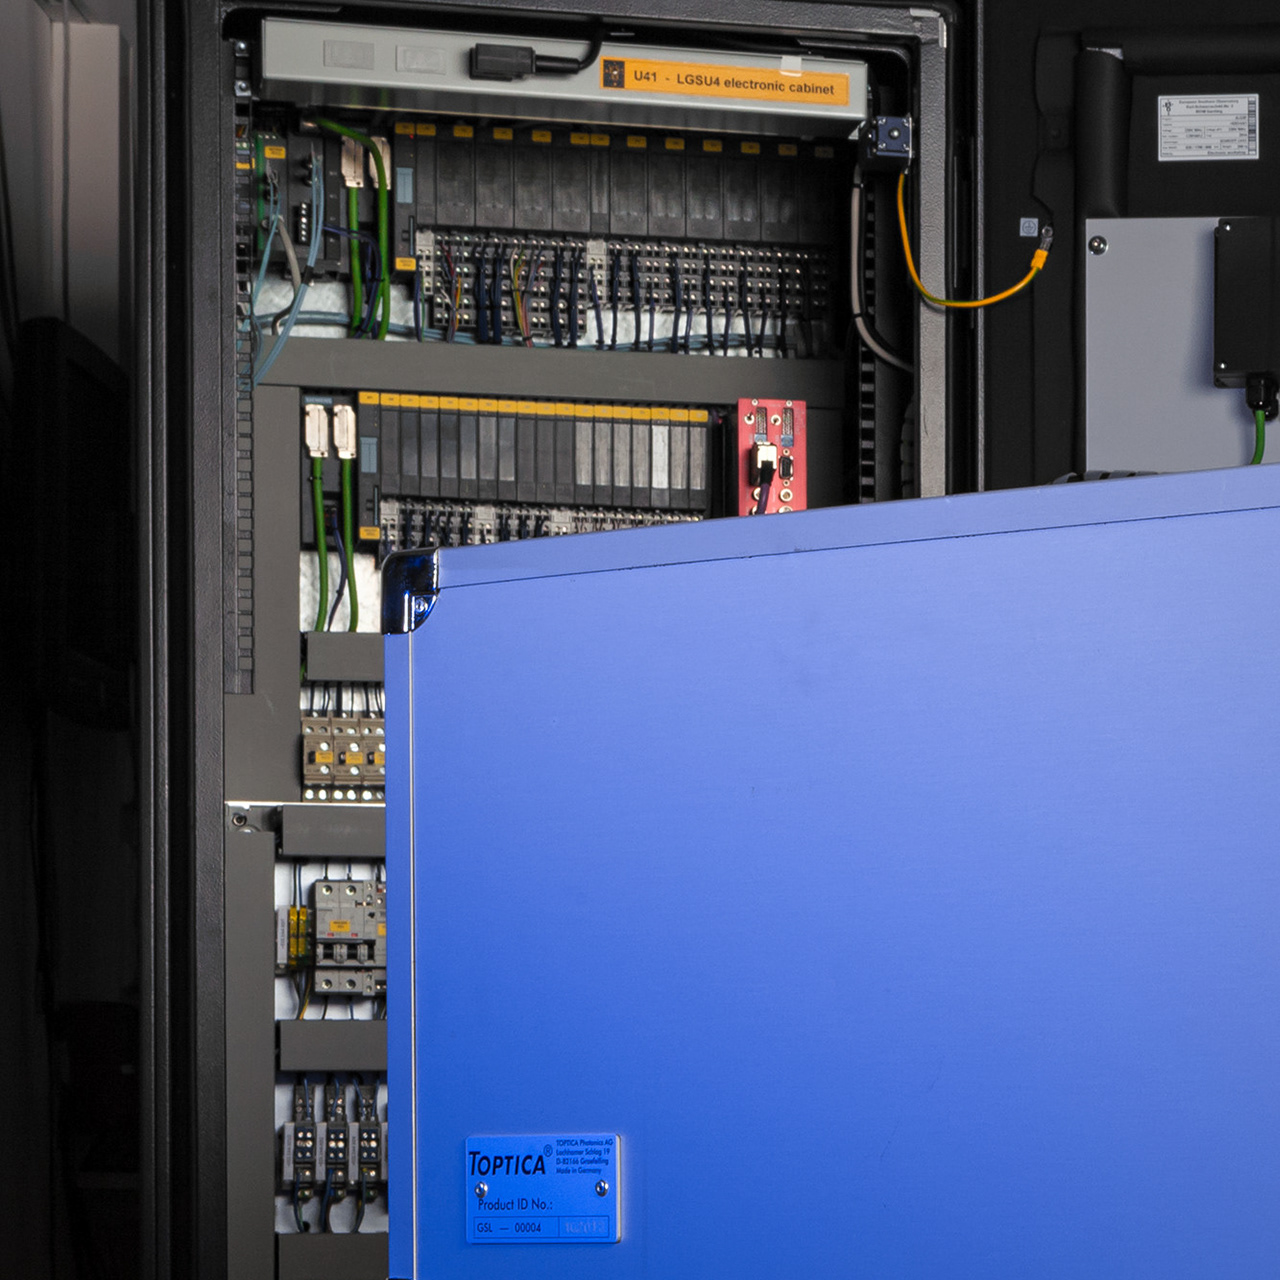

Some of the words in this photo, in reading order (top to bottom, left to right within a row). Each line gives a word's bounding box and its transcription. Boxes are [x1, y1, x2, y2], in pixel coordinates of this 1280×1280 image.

[634, 70, 657, 82] U41
[677, 74, 720, 87] LGSU4
[724, 78, 785, 92] electronic
[789, 82, 835, 96] cabinet
[556, 1139, 579, 1147] TOPTICA
[478, 1198, 514, 1211] Product
[517, 1198, 528, 1210] ID
[531, 1199, 553, 1211] No.:
[477, 1222, 493, 1233] GSL
[514, 1222, 541, 1233] 00004
